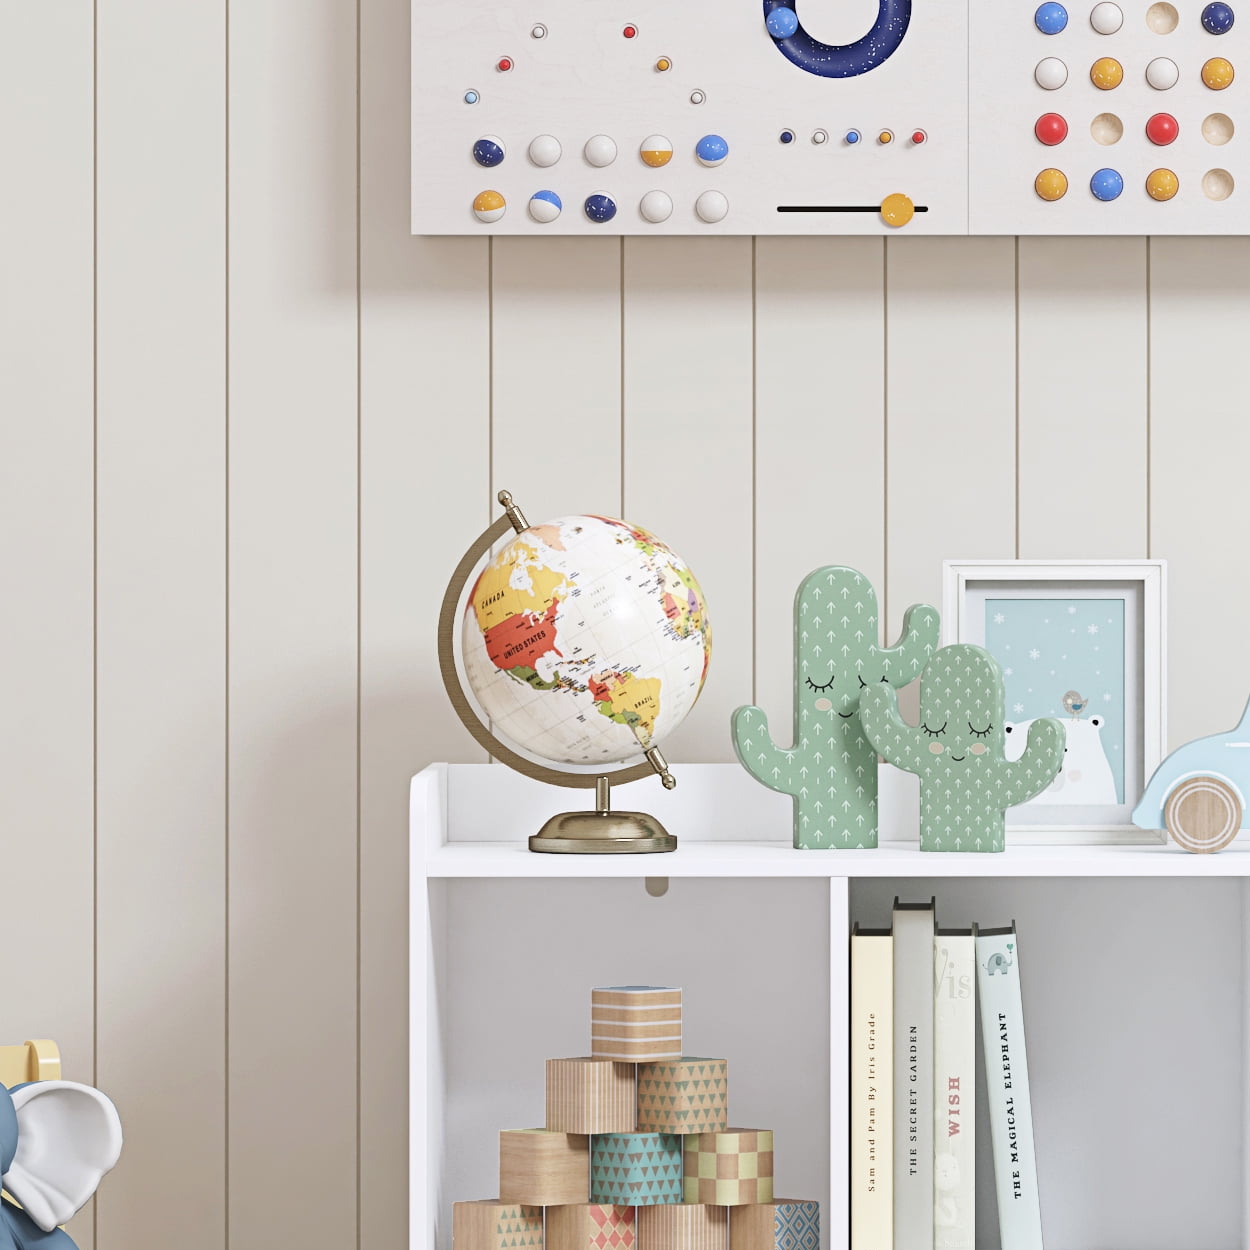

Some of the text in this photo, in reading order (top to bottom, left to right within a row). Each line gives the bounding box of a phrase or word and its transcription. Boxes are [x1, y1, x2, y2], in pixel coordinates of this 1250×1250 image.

[481, 590, 505, 609] CANADA
[503, 630, 547, 659] UNITED STATES
[634, 696, 653, 709] BRAZIL
[867, 1013, 877, 1192] Sam and Pam By Iris Grade
[909, 1026, 917, 1176] THE SECRET GARDEN
[948, 1077, 961, 1138] WISH
[998, 1013, 1022, 1199] THE MAGICAL ELEPHANT
